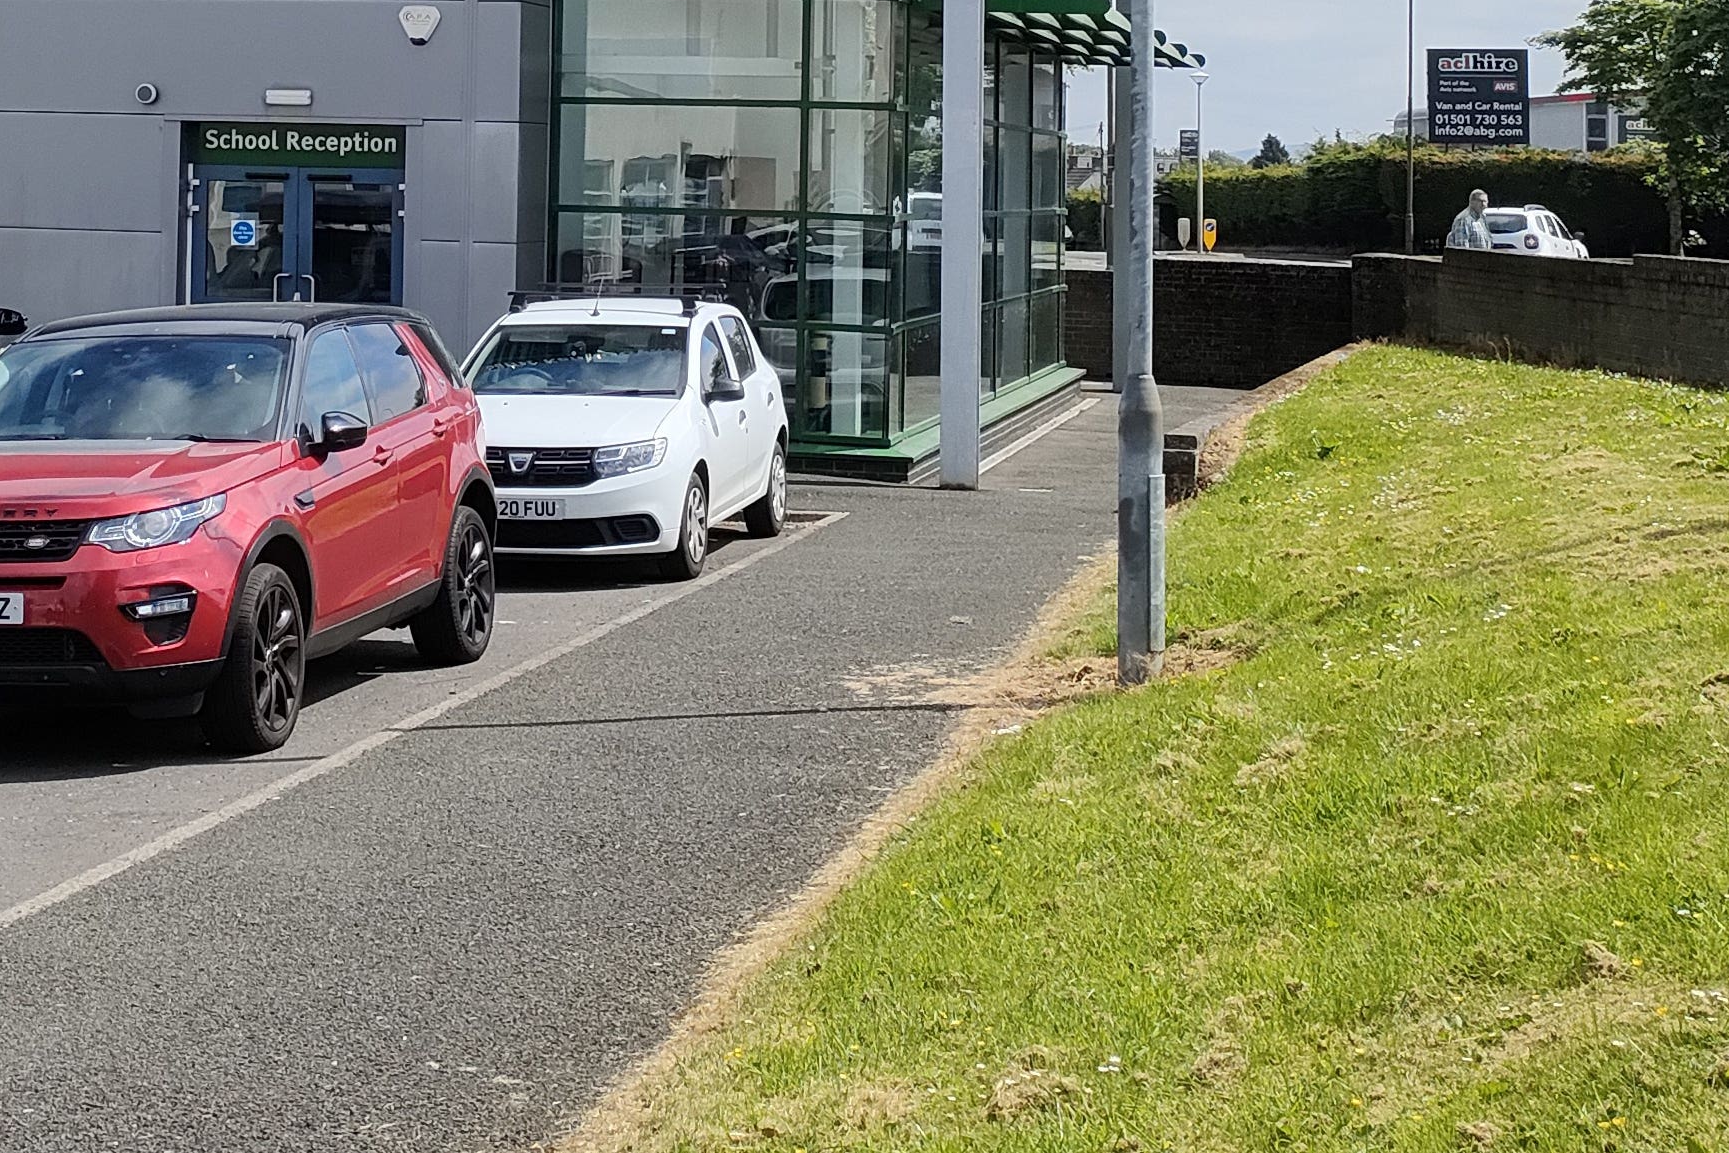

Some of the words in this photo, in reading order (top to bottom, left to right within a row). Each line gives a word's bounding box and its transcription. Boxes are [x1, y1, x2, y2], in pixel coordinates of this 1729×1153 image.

[1438, 53, 1519, 72] aclhire
[1494, 82, 1515, 91] AVIS
[1435, 101, 1453, 110] Van
[1455, 101, 1472, 110] and
[1474, 102, 1491, 110] Car
[1493, 102, 1522, 110] Rental
[1435, 114, 1471, 124] 01501
[1474, 114, 1498, 125] 730
[1500, 114, 1522, 125] 563
[1435, 125, 1523, 139] info2@abg.com
[205, 129, 280, 151] School
[286, 131, 397, 157] Reception
[499, 500, 519, 516] 20
[524, 501, 556, 516] FUU
